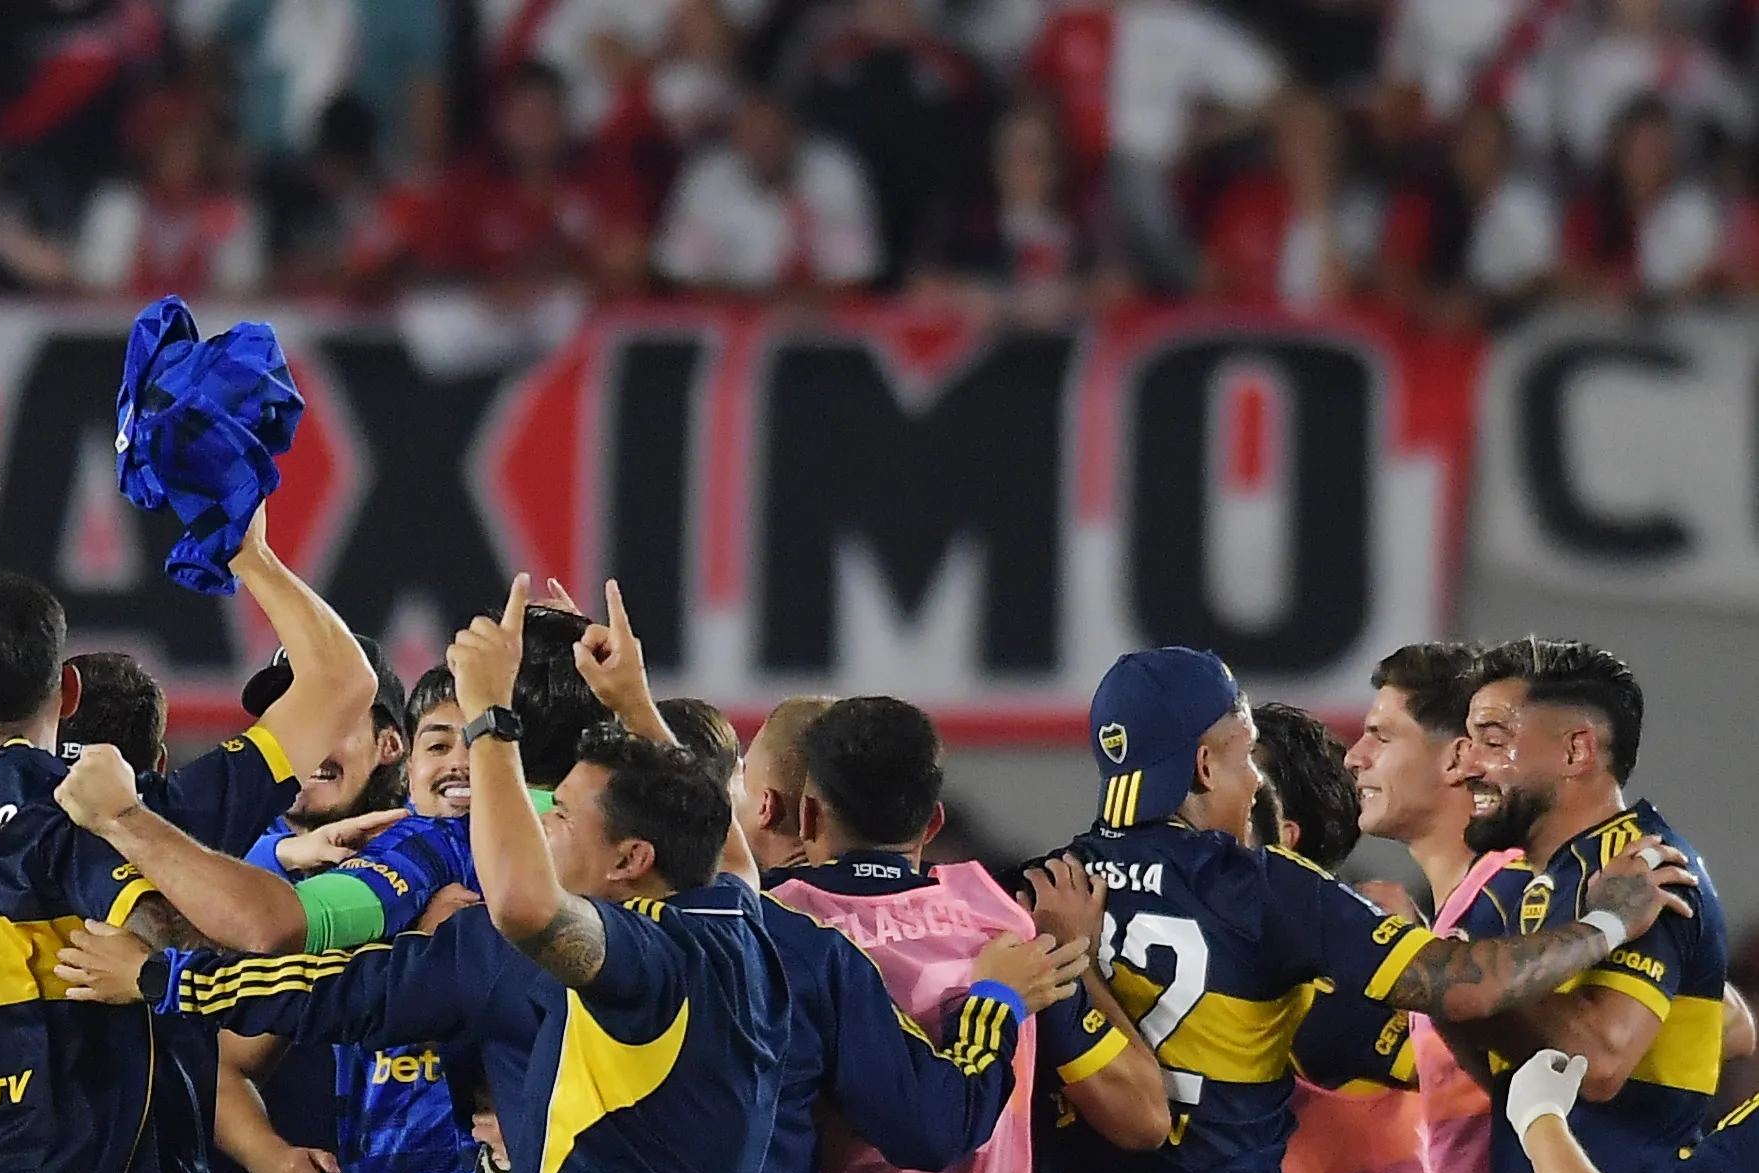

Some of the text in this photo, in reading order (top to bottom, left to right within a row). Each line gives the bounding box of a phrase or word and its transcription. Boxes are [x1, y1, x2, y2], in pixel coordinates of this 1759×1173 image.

[852, 863, 902, 879] 1905
[1612, 949, 1665, 983] OGAR
[372, 1050, 441, 1084] bet
